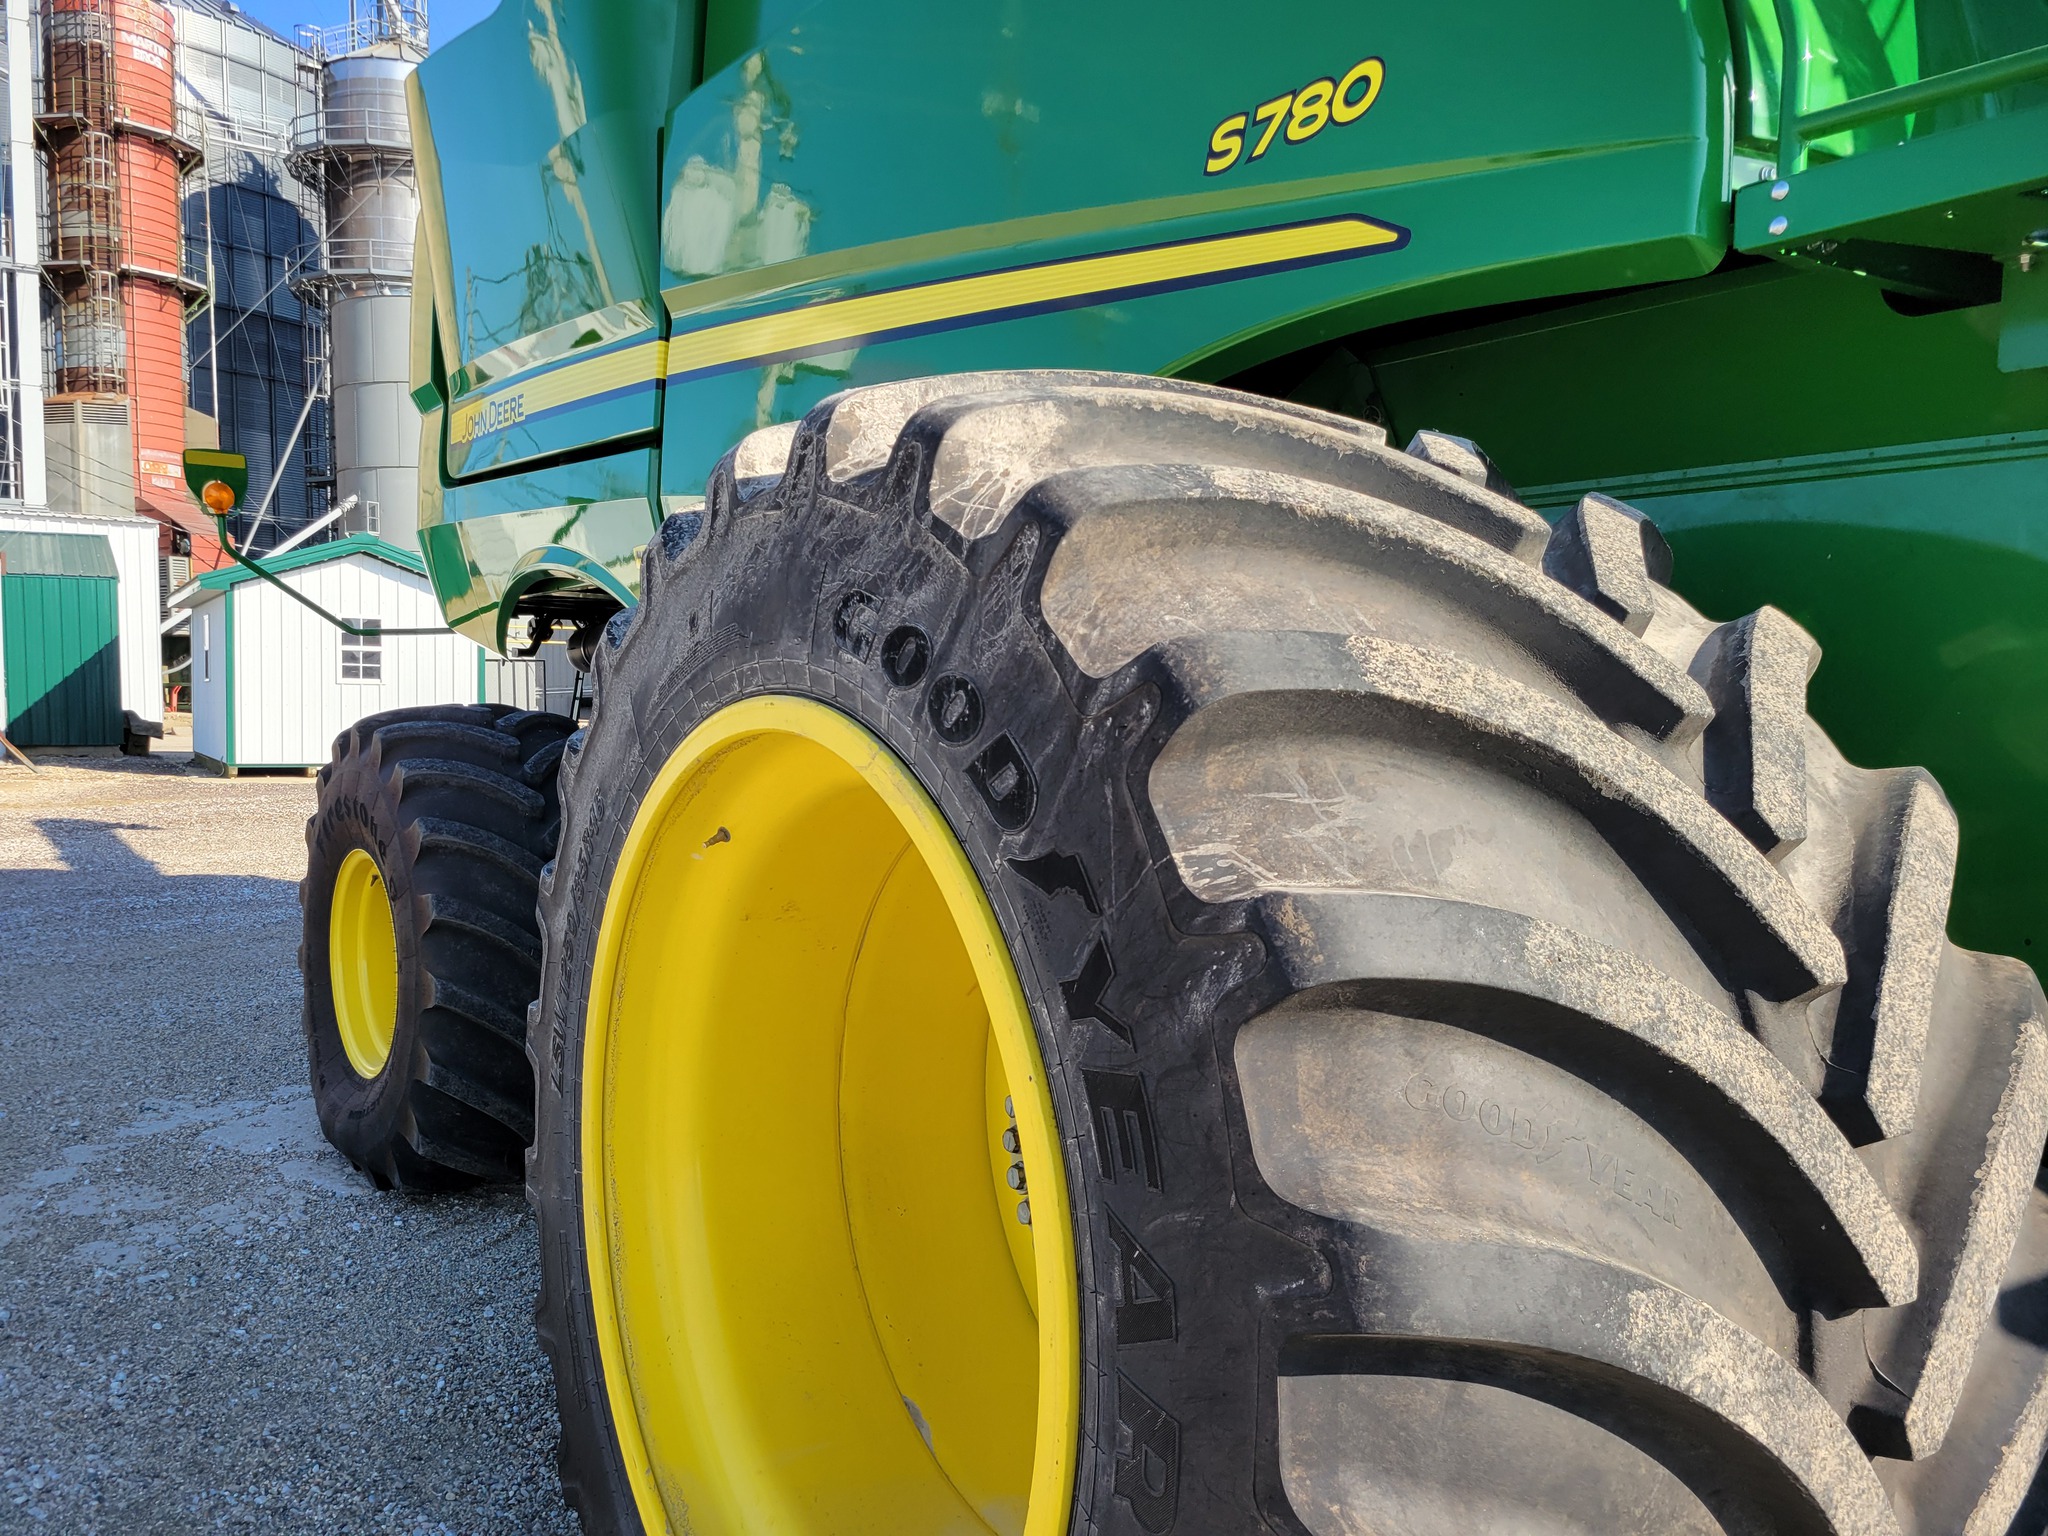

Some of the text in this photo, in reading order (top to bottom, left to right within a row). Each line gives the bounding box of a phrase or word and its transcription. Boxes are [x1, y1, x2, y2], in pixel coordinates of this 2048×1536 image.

[121, 32, 168, 60] MARTIN
[1203, 56, 1386, 176] S780
[462, 394, 525, 443] JOHN DEERE
[833, 588, 1182, 1536] GOODYEAR
